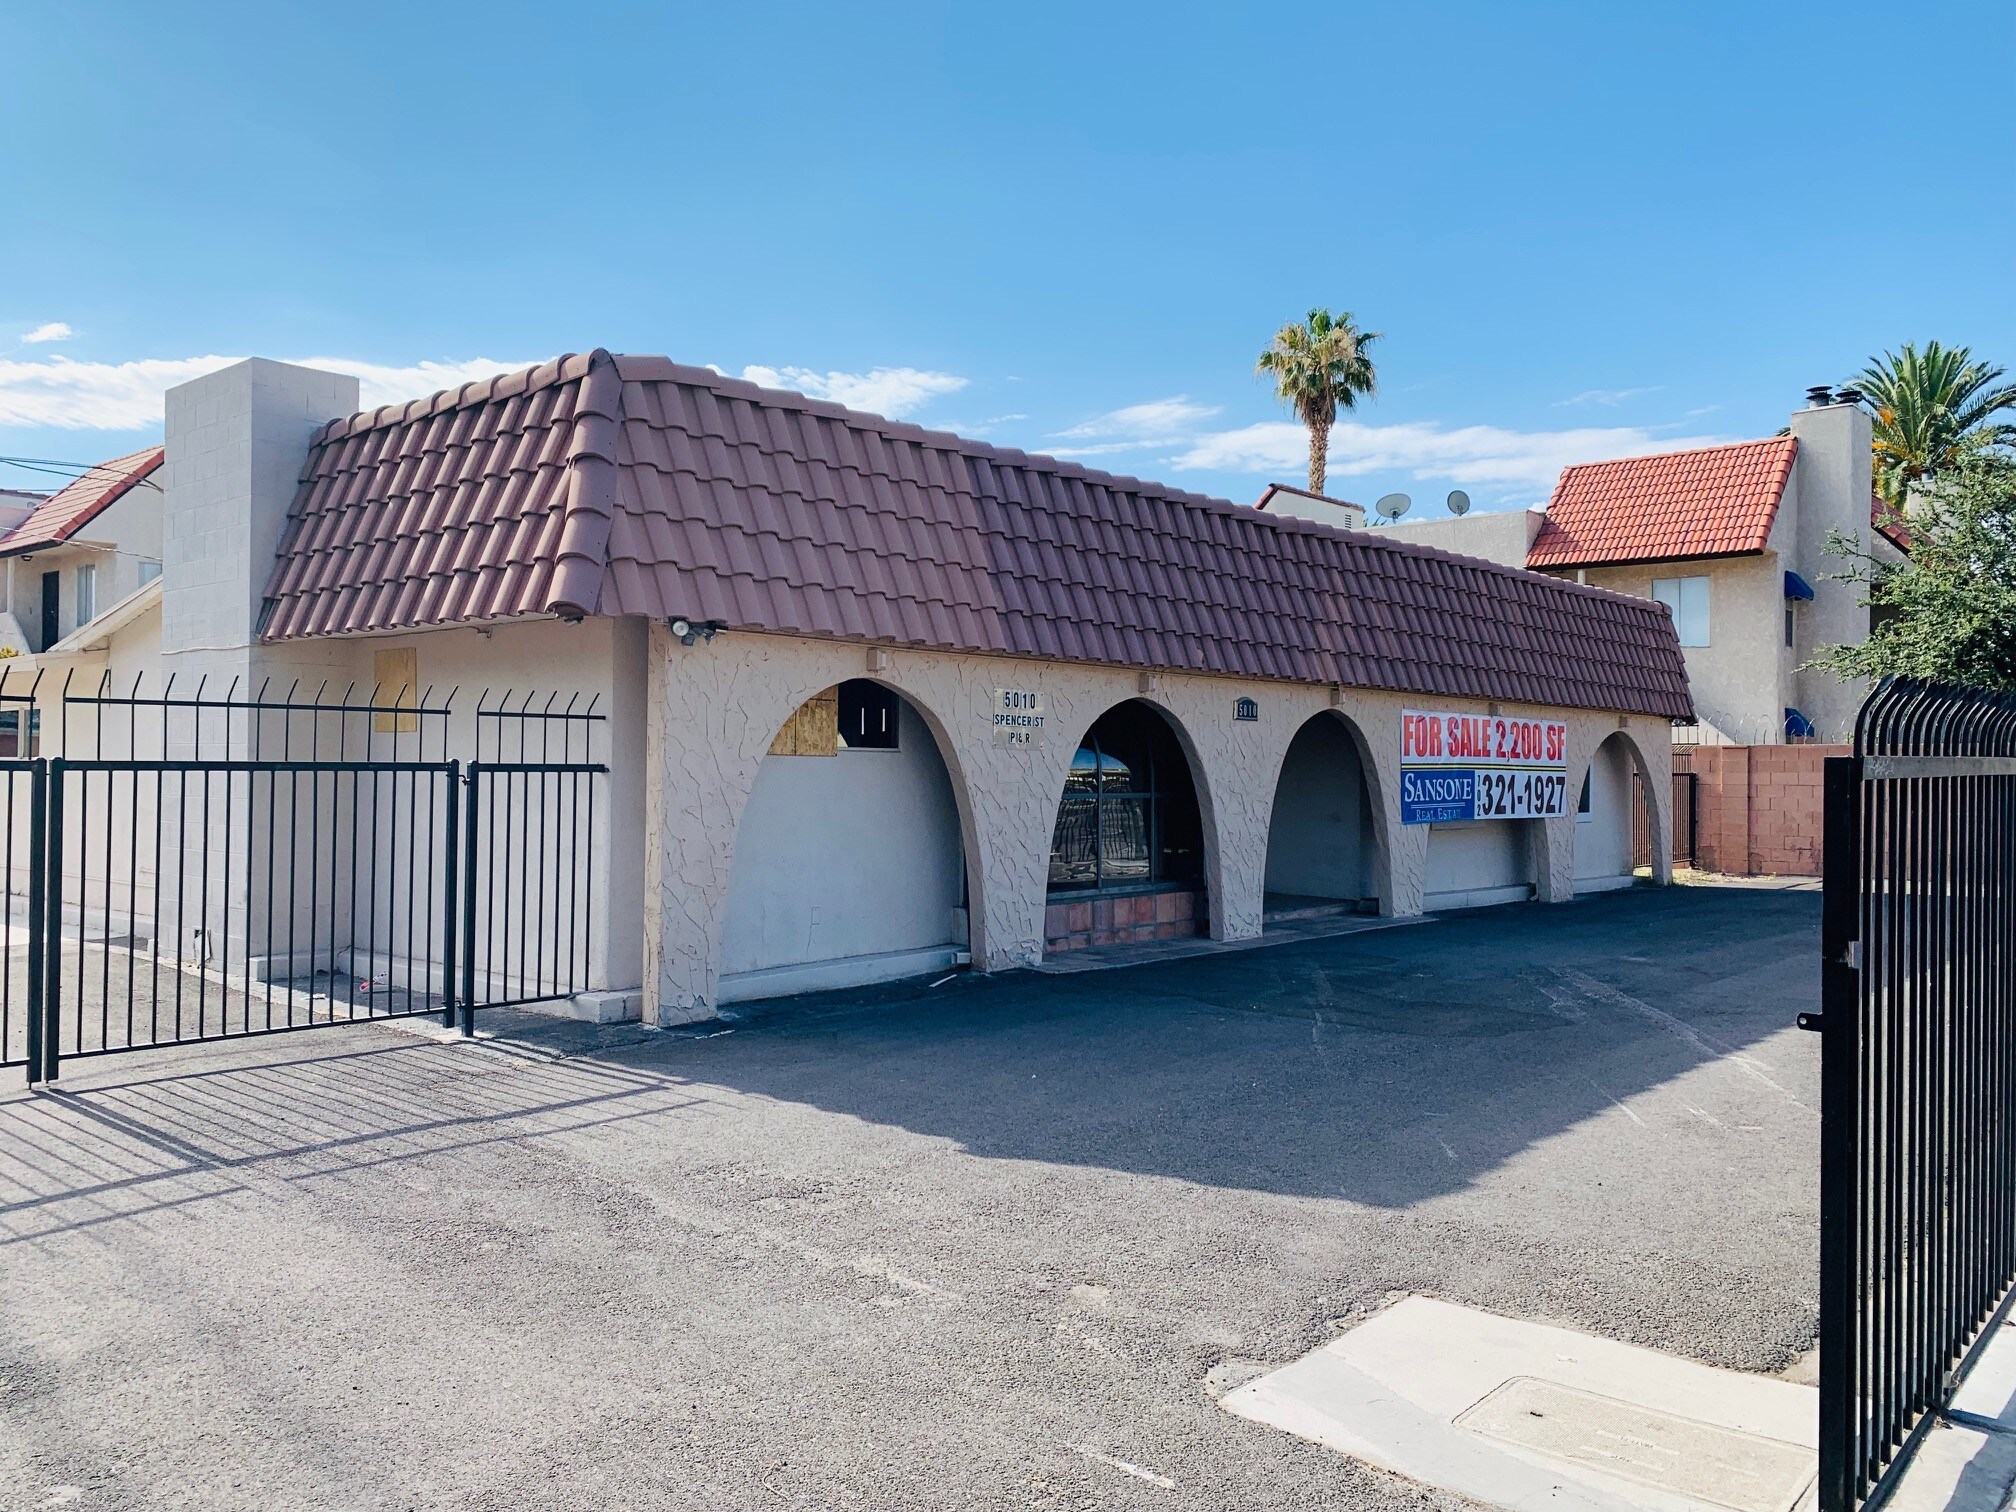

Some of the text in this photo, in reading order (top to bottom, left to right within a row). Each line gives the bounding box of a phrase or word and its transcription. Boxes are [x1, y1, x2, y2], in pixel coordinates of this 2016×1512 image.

[1005, 692, 1036, 709] 5010
[1240, 704, 1256, 717] 5010
[995, 714, 1031, 726] SPENCER
[1403, 715, 1565, 762] FOR SALE 2,200 SF
[1404, 773, 1472, 802] SANSONE
[1483, 774, 1565, 815] 321-1927
[1416, 809, 1435, 821] REAL
